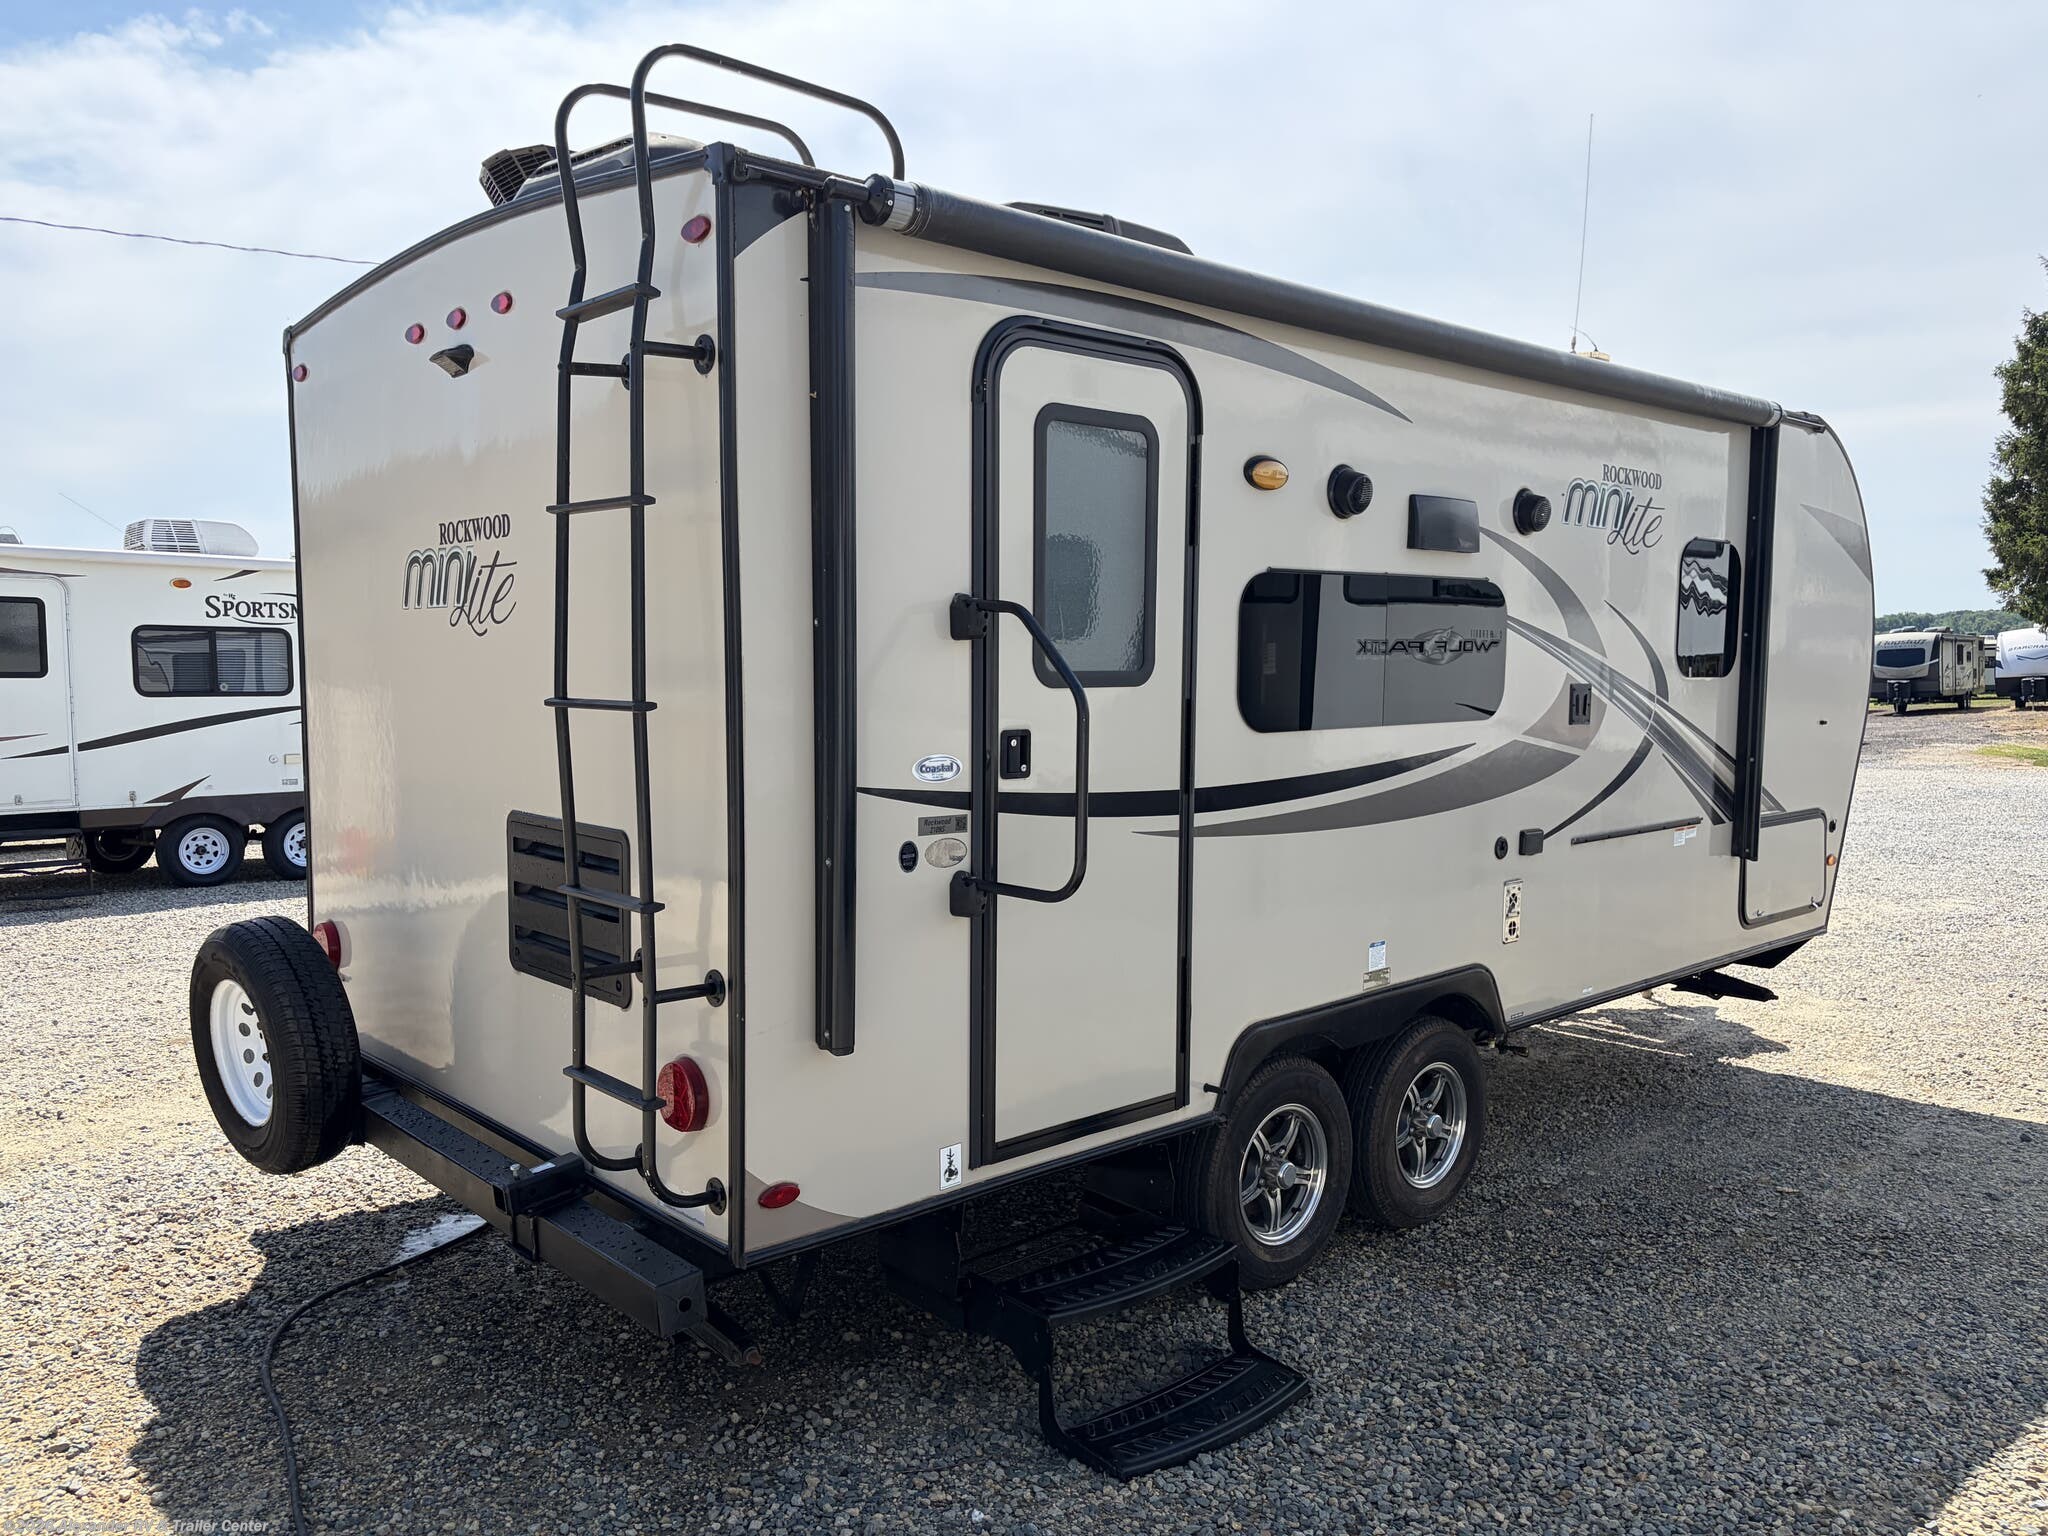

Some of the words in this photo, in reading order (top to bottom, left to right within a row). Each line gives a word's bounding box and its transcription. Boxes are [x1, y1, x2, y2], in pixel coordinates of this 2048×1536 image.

[1602, 464, 1662, 490] ROCKWOOD
[439, 513, 511, 545] ROCKWOOD
[920, 762, 954, 774] Coastal
